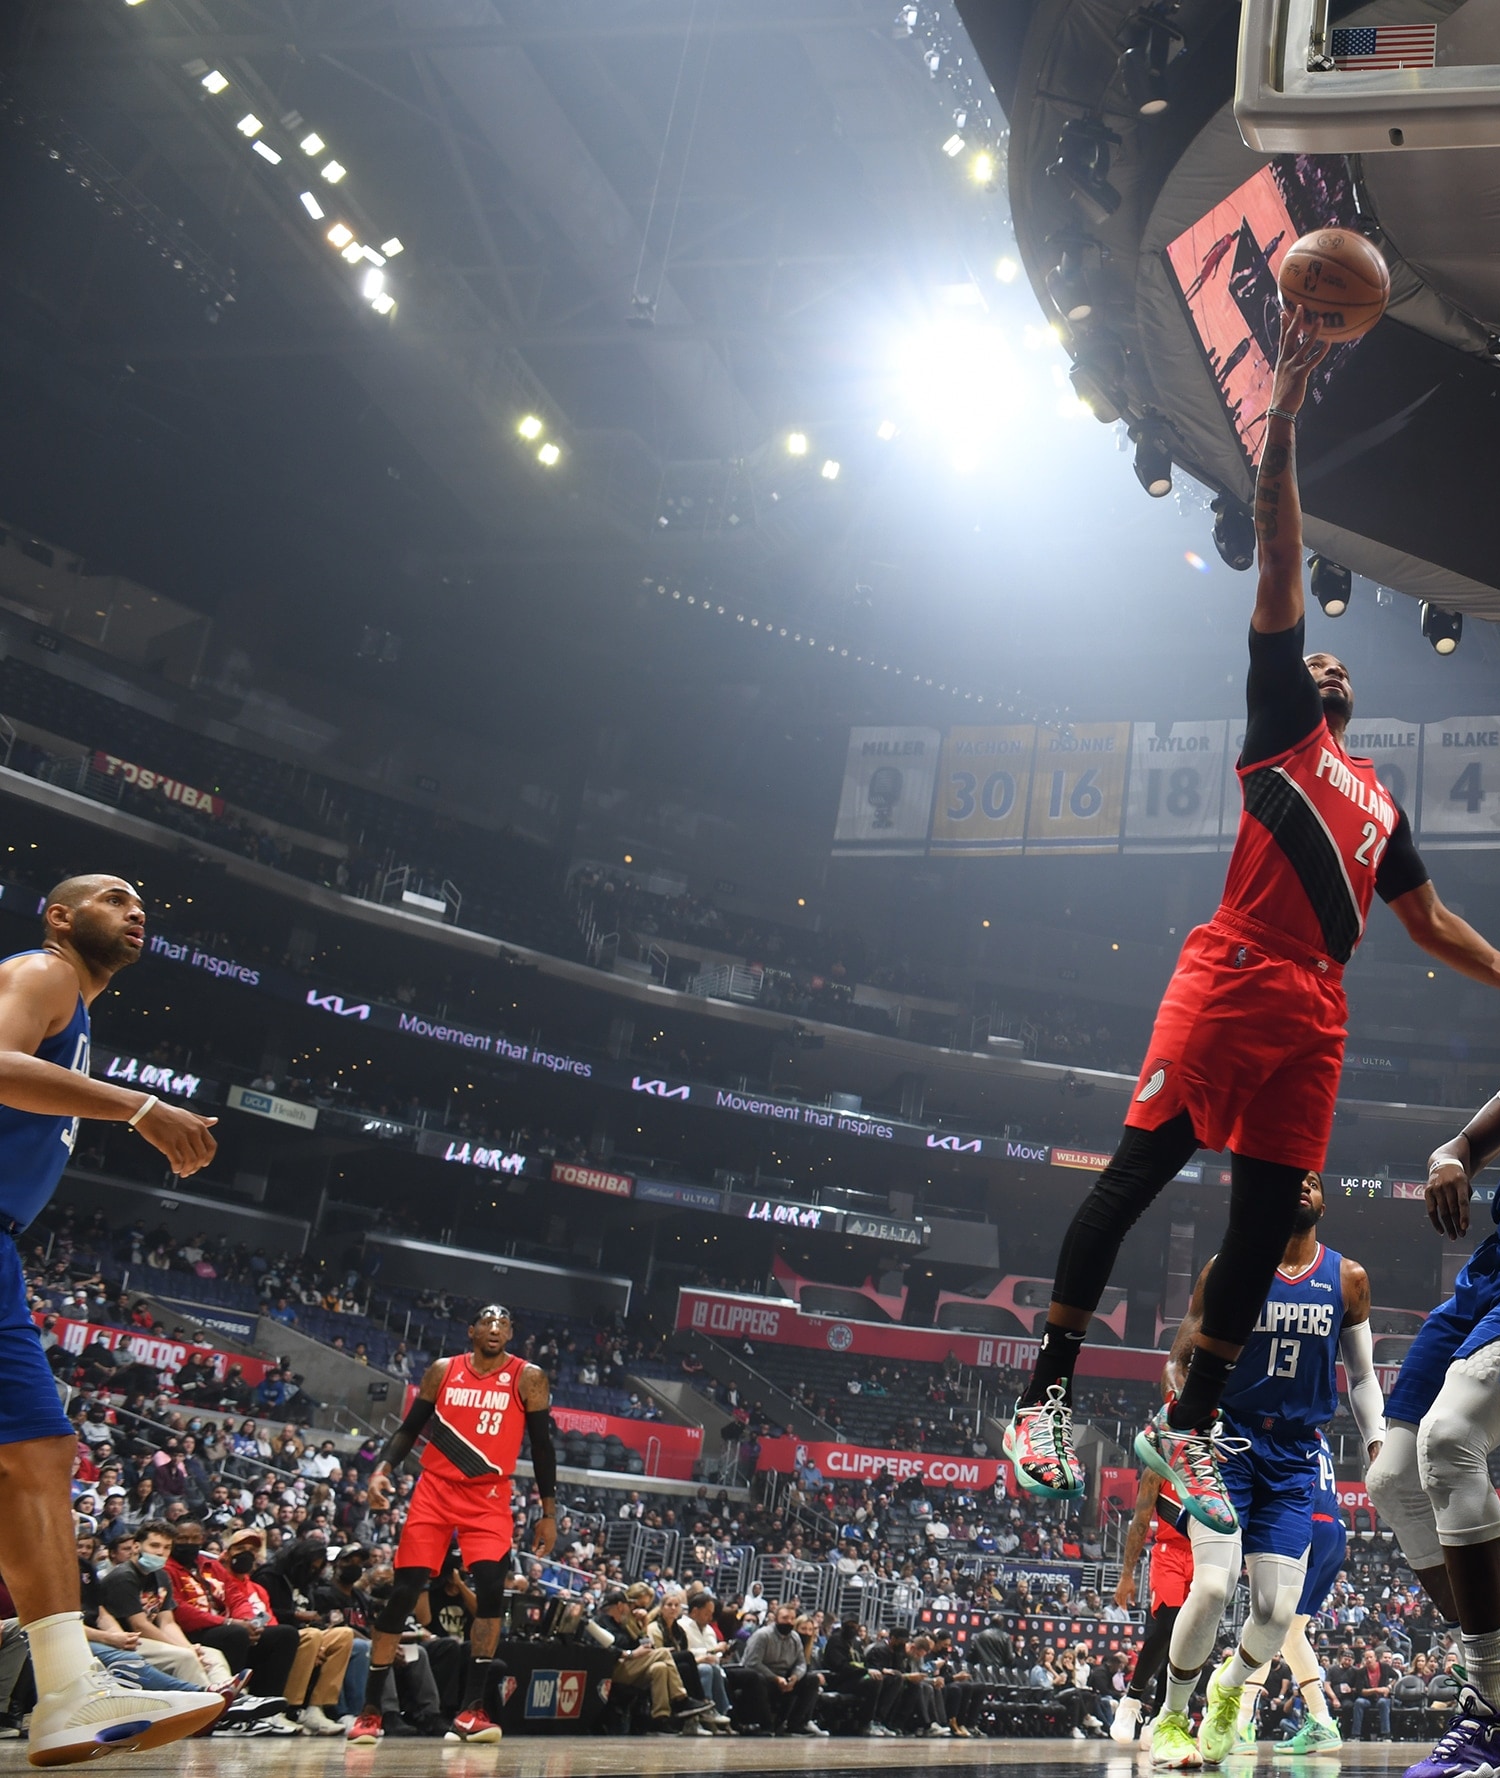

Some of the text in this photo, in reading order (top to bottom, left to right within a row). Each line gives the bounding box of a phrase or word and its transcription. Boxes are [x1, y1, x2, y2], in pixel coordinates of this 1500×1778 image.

[861, 740, 925, 758] MILLER
[955, 739, 1024, 756] VACHON
[1148, 736, 1210, 753] TAYLOR
[1345, 732, 1416, 749] OBITAILLE
[1441, 731, 1499, 748] BLAKE
[105, 754, 215, 815] TOSHIBA
[946, 769, 1018, 822] 30
[1047, 768, 1105, 821] 16
[1145, 766, 1203, 819] 18
[1316, 748, 1398, 836] PORTLAND
[1450, 761, 1485, 815] 4
[150, 933, 261, 988] that inspires
[398, 1012, 492, 1052] Movement
[496, 1037, 529, 1062] that
[531, 1047, 593, 1078] inspires
[1362, 1057, 1392, 1067] ULTRA
[243, 1093, 307, 1122] UCLA Health
[716, 1090, 800, 1121] Movement
[804, 1108, 834, 1128] that
[837, 1113, 894, 1140] inspires
[1056, 1152, 1113, 1168] WELLS FAR
[553, 1163, 631, 1195] TOSHIBA
[1340, 1177, 1382, 1189] LAC POR
[1345, 1187, 1375, 1198] 2 2
[682, 1192, 716, 1207] ULTRA
[868, 1222, 918, 1242] DELTA
[1309, 1278, 1333, 1293] honey
[710, 1303, 780, 1337] CLIPPERS
[1252, 1301, 1335, 1337] LIPPERS
[996, 1342, 1039, 1371] CLIPP
[1267, 1337, 1301, 1379] 13
[445, 1387, 510, 1411] PORTLAND
[476, 1410, 503, 1436] 33
[826, 1450, 980, 1484] CLIPPERS.COM
[1104, 1470, 1118, 1479] 115
[1317, 1452, 1336, 1496] 14
[532, 1679, 555, 1709] NBA
